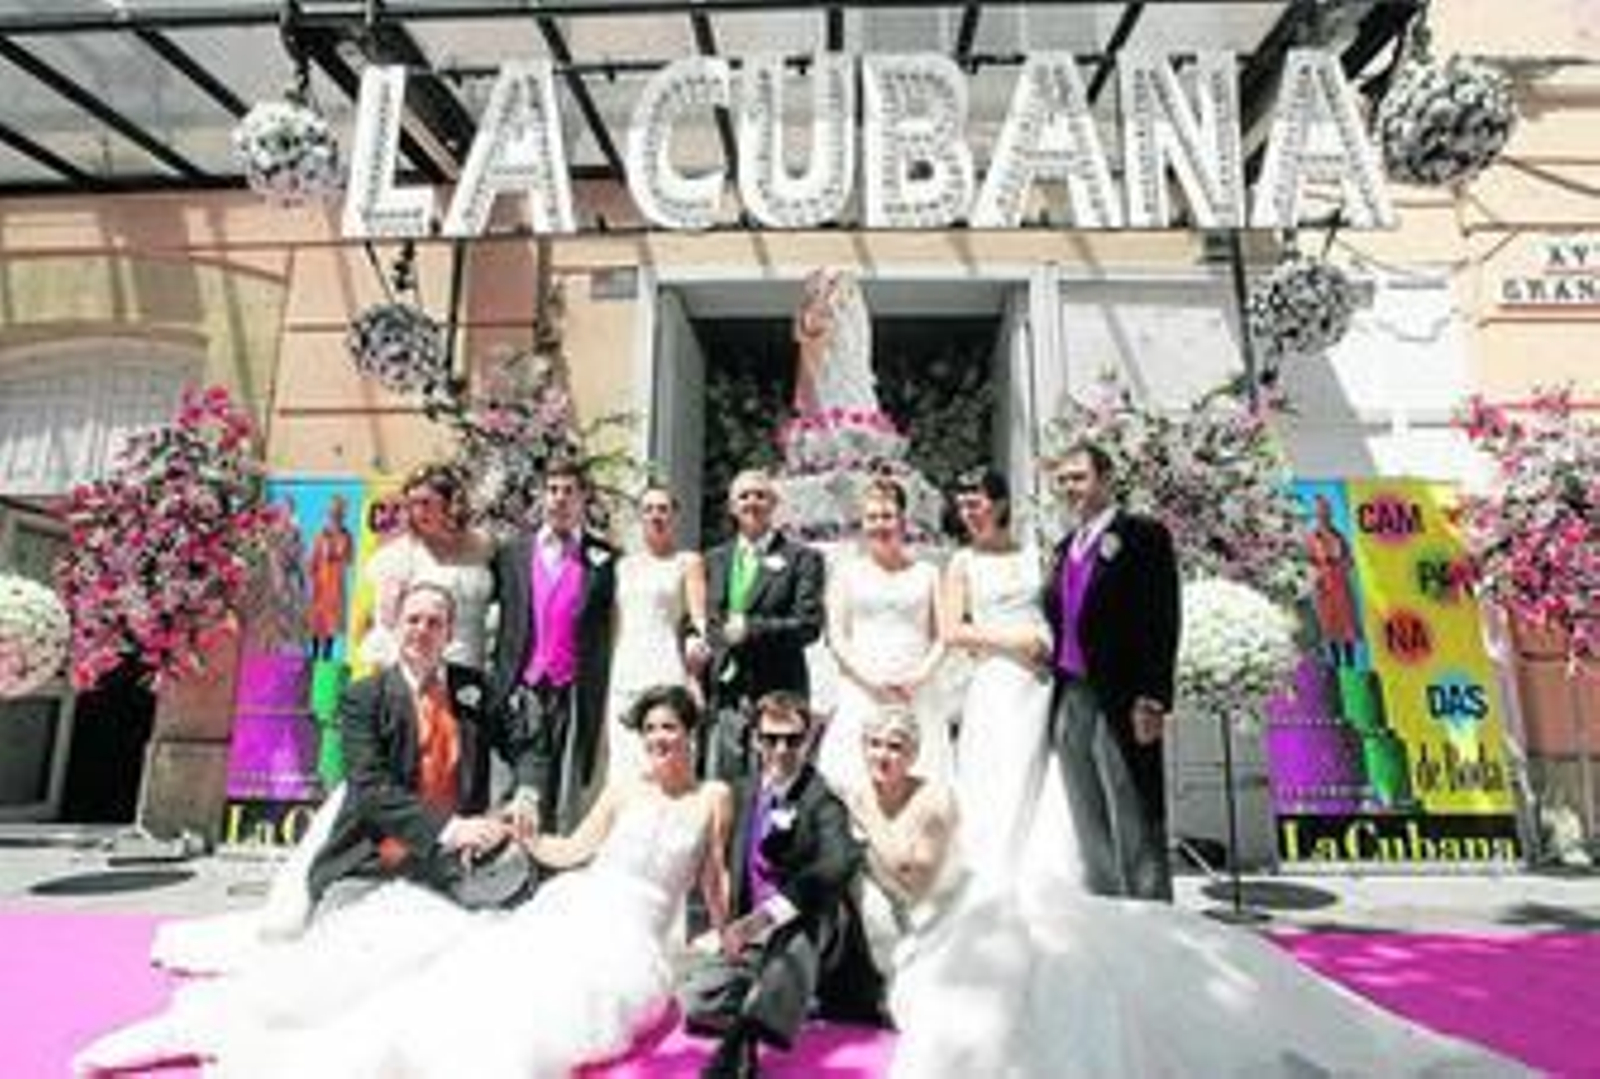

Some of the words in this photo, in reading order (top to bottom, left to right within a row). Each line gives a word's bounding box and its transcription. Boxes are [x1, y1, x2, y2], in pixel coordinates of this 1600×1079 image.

[341, 56, 578, 238] LA
[626, 50, 1400, 229] CUBANA
[1358, 503, 1425, 533] CAM
[1386, 618, 1431, 655] NA
[1427, 684, 1488, 719] DAS
[1281, 819, 1338, 862] La
[1344, 819, 1516, 864] Cubana
